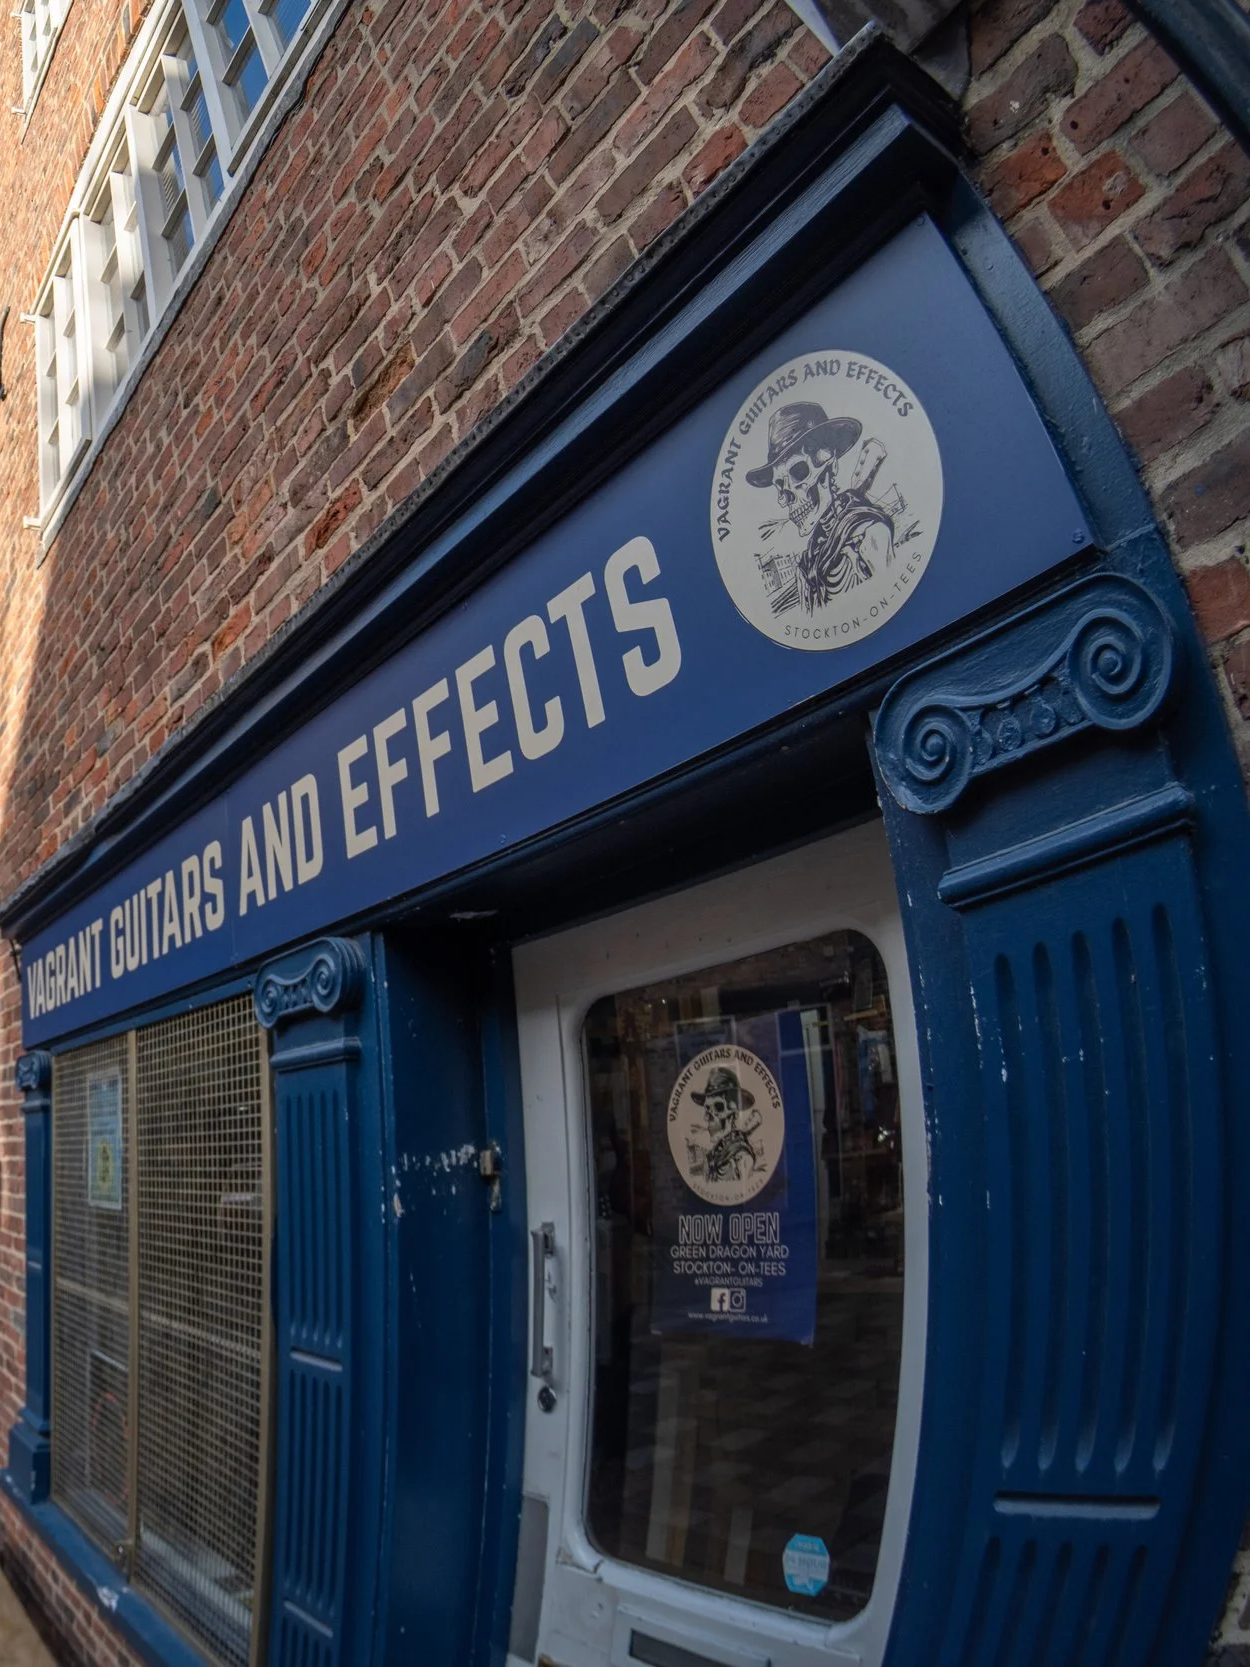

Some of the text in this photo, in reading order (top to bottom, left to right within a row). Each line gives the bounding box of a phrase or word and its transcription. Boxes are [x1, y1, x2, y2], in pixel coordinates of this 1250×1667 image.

[717, 358, 914, 542] VAGRANT GUITARS AND EFFECTS
[27, 536, 682, 1020] VAGRANT GUITARS AND EFFECTS
[669, 1048, 781, 1122] VAGRANT GUITARS AND EFFECTS
[670, 1244, 790, 1259] GREEN DRAGON YARD
[678, 1211, 780, 1245] NOW OPEN
[738, 1261, 787, 1276] ON-TEES
